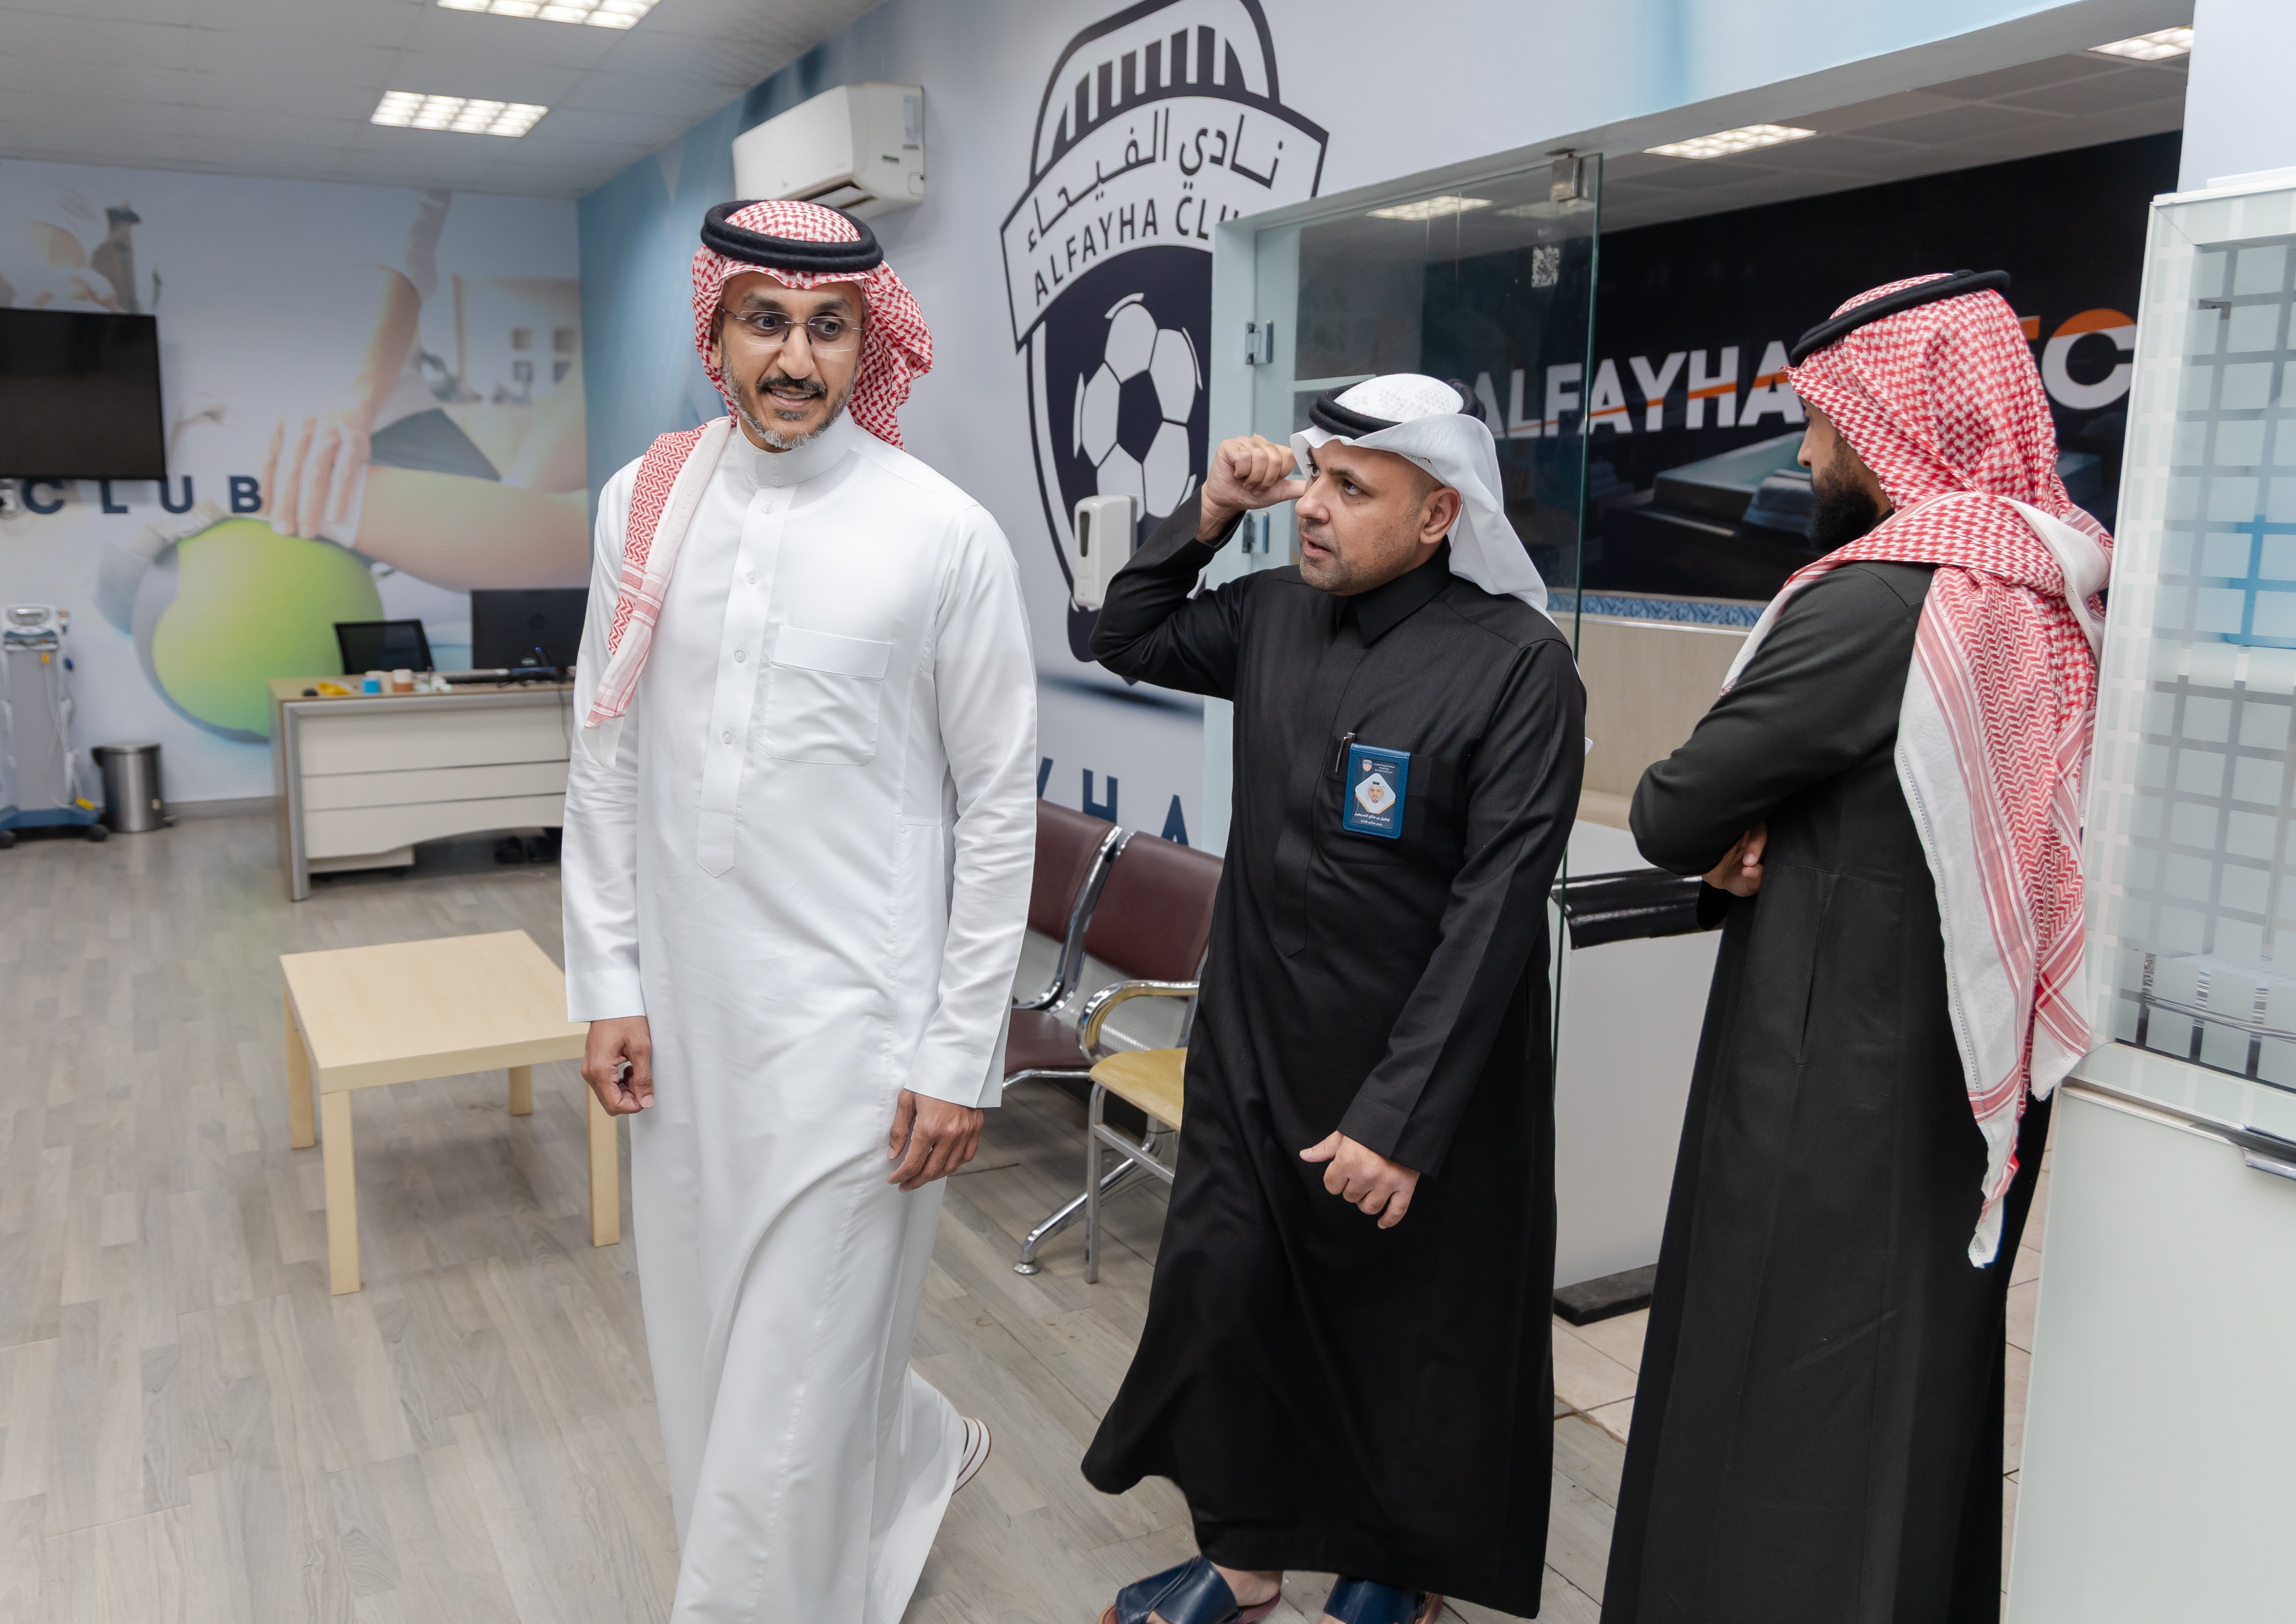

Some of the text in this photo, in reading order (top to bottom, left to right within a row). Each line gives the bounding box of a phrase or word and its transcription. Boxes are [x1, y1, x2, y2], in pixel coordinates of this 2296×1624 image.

[1027, 107, 1284, 253] نادي الفيحاء
[1035, 195, 1240, 308] ALFAYHA CL
[1473, 308, 2137, 440] ALFAYHA C
[22, 475, 263, 515] CLUB
